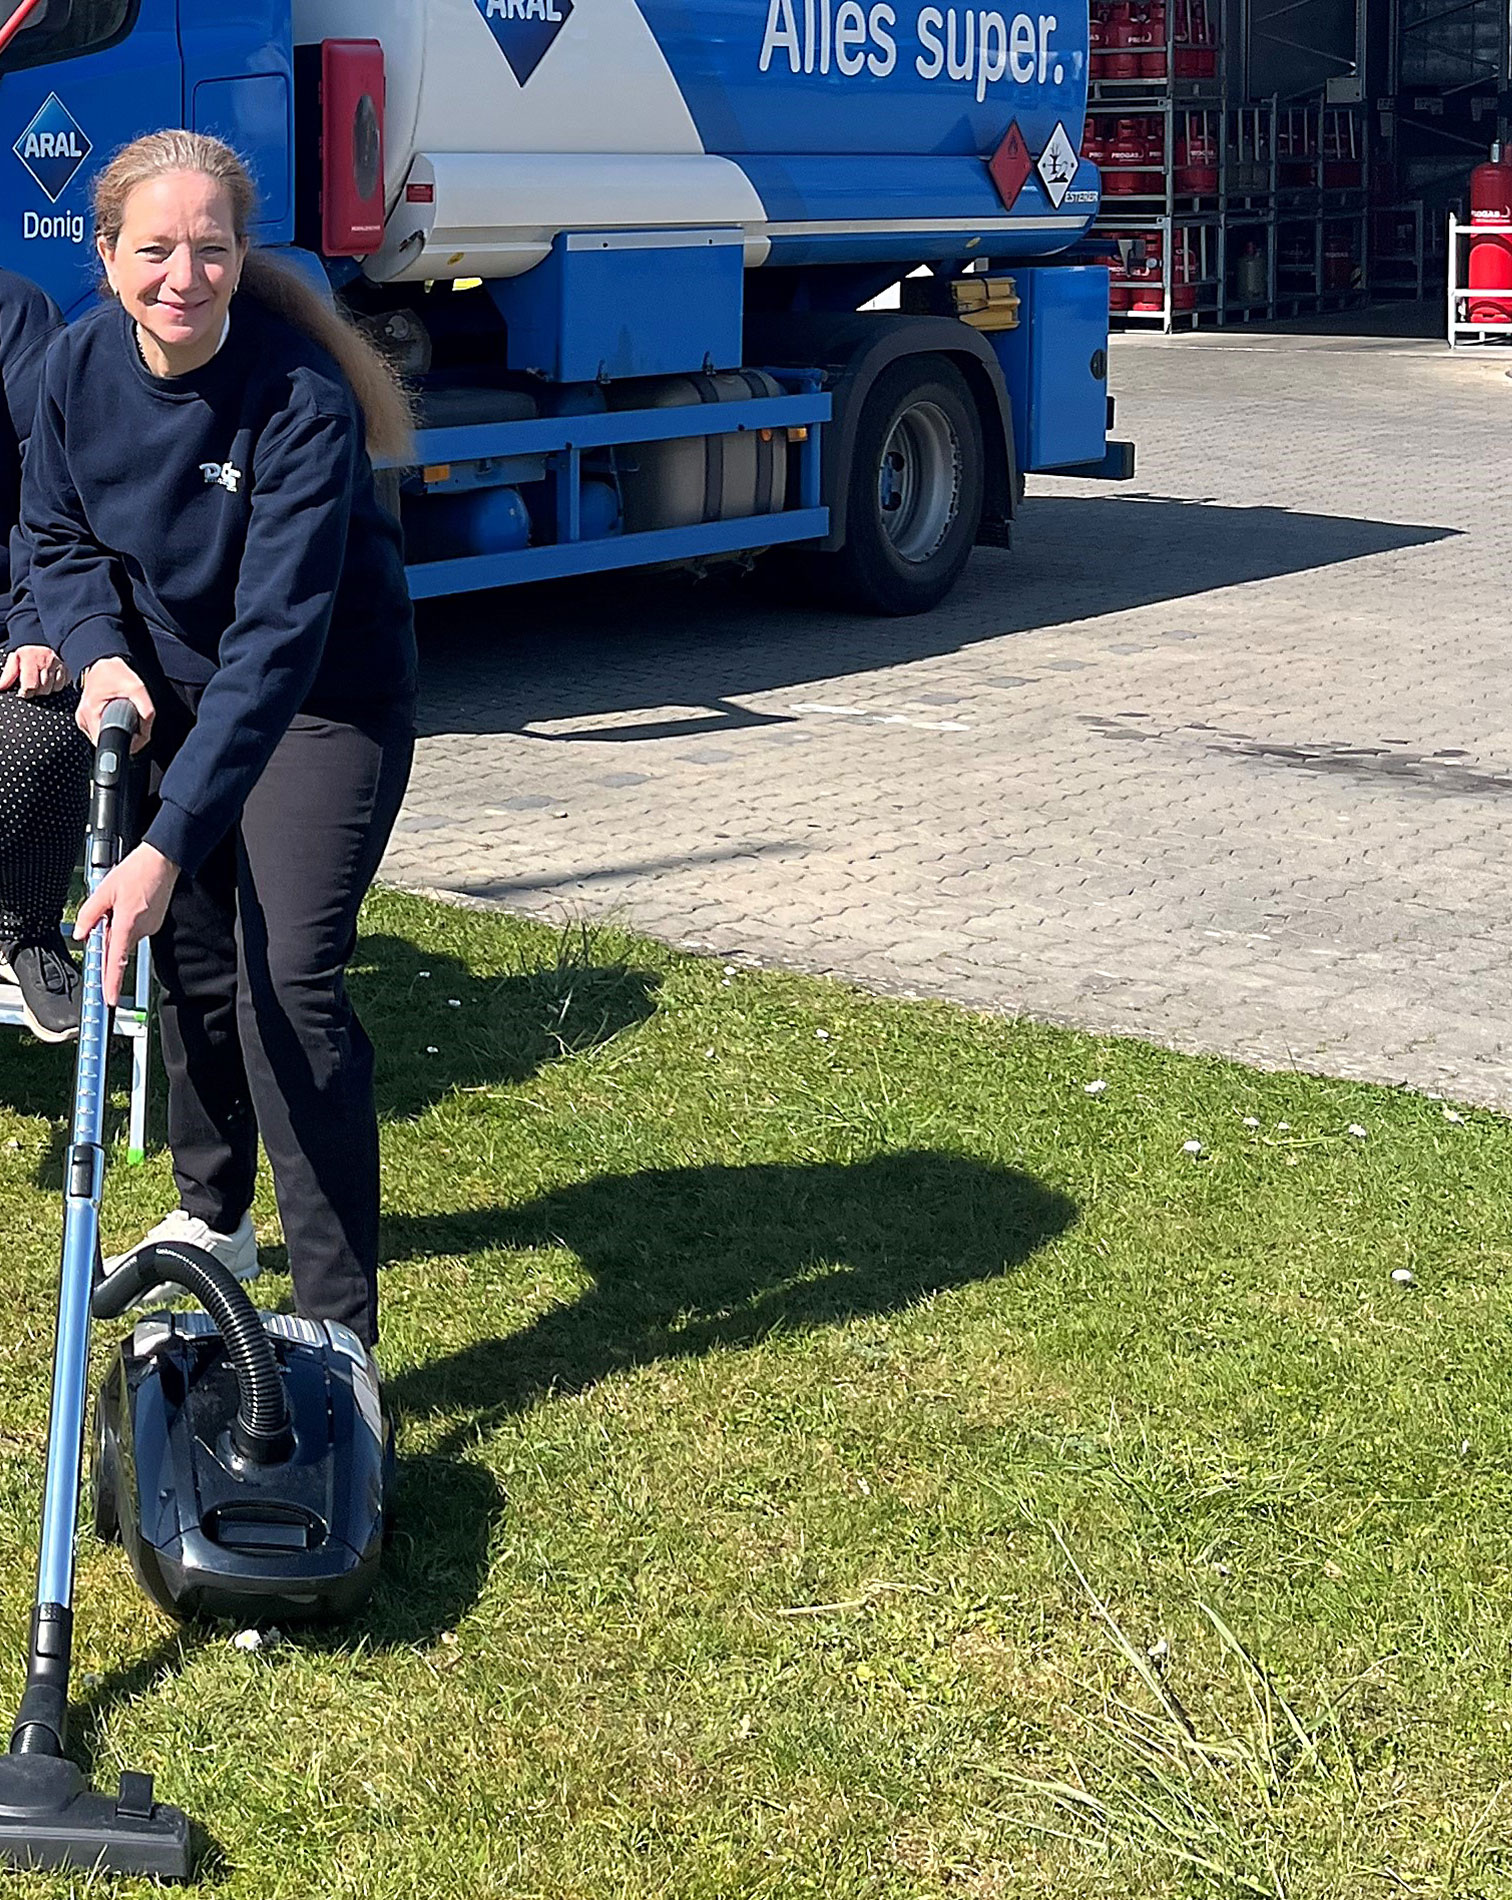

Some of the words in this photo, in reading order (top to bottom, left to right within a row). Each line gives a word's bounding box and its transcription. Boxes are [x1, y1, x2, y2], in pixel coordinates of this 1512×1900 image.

[486, 0, 562, 21] ARAL
[759, 0, 896, 77] Alles
[915, 7, 1064, 103] super.
[24, 131, 83, 158] ARAL
[23, 210, 84, 243] Donig
